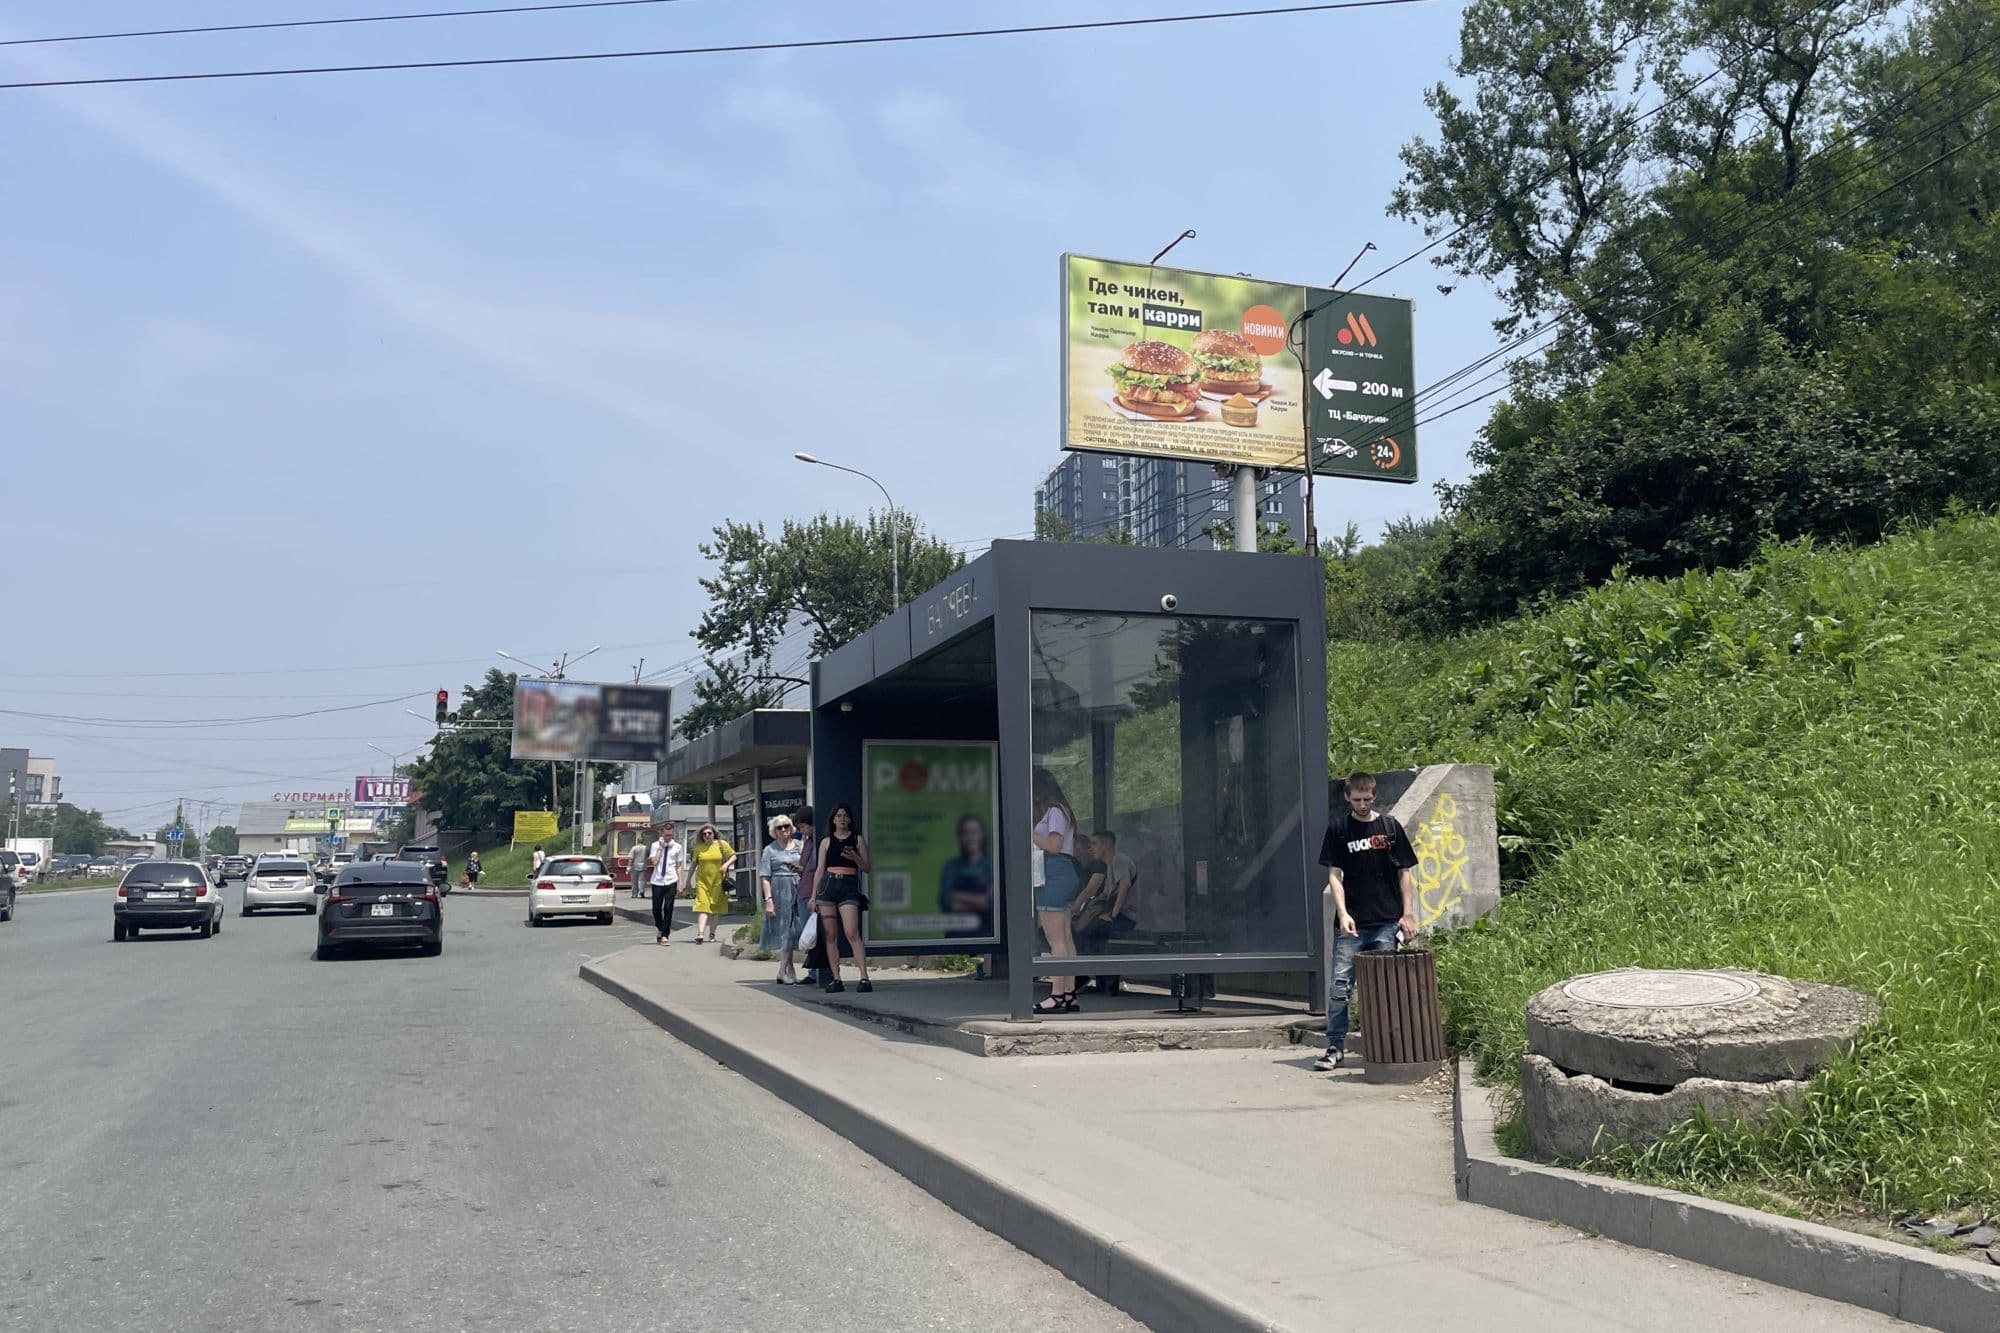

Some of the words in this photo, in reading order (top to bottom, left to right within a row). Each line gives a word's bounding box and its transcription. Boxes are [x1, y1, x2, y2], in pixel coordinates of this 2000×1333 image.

[1088, 277, 1118, 296] Где
[1123, 285, 1185, 306] чикен,
[1087, 301, 1123, 317] там
[1128, 306, 1139, 319] и
[1144, 309, 1200, 328] карри
[1244, 322, 1285, 338] НОВИНКИ
[1362, 381, 1389, 396] 200
[1328, 409, 1341, 420] ТЦ
[1347, 837, 1372, 853] FUCK
